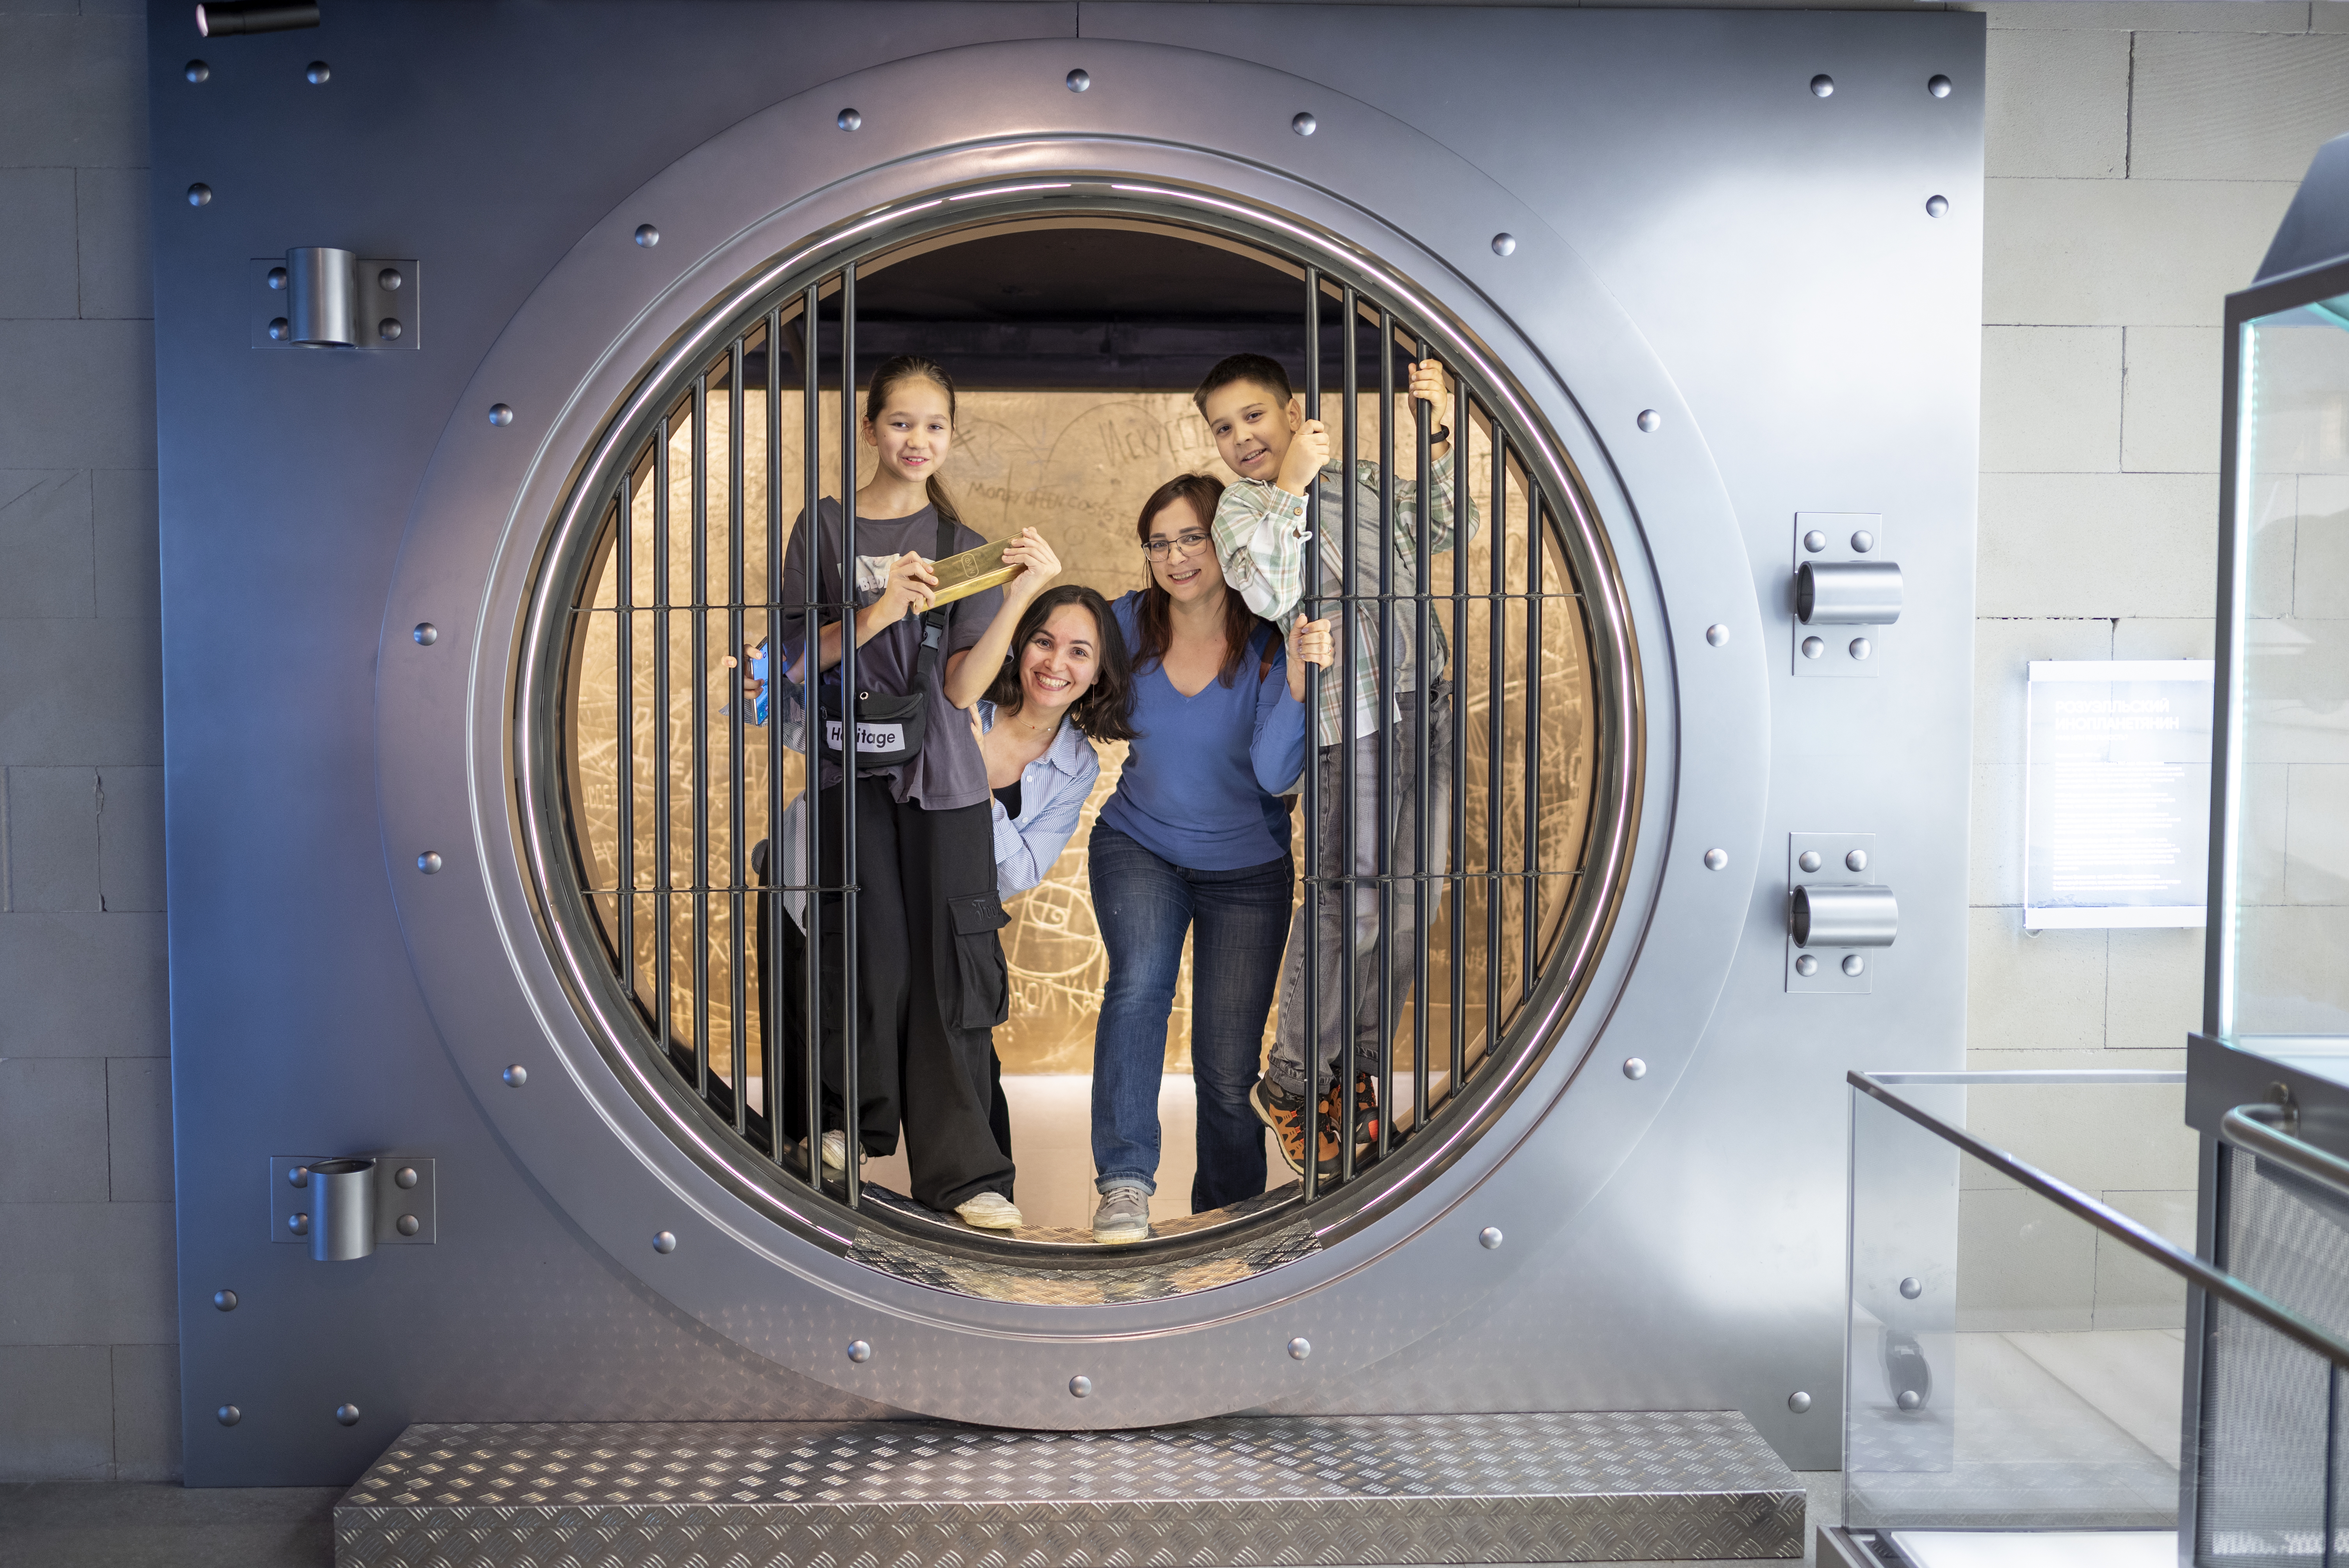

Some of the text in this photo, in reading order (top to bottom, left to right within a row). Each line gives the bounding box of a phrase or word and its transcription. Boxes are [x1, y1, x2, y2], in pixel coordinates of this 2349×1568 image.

[2055, 698, 2169, 713] РОЗУЭЛЛЬСКИЙ
[2055, 716, 2179, 730] ИНОПЛАНЕТЯНИН
[831, 727, 895, 748] Hitage
